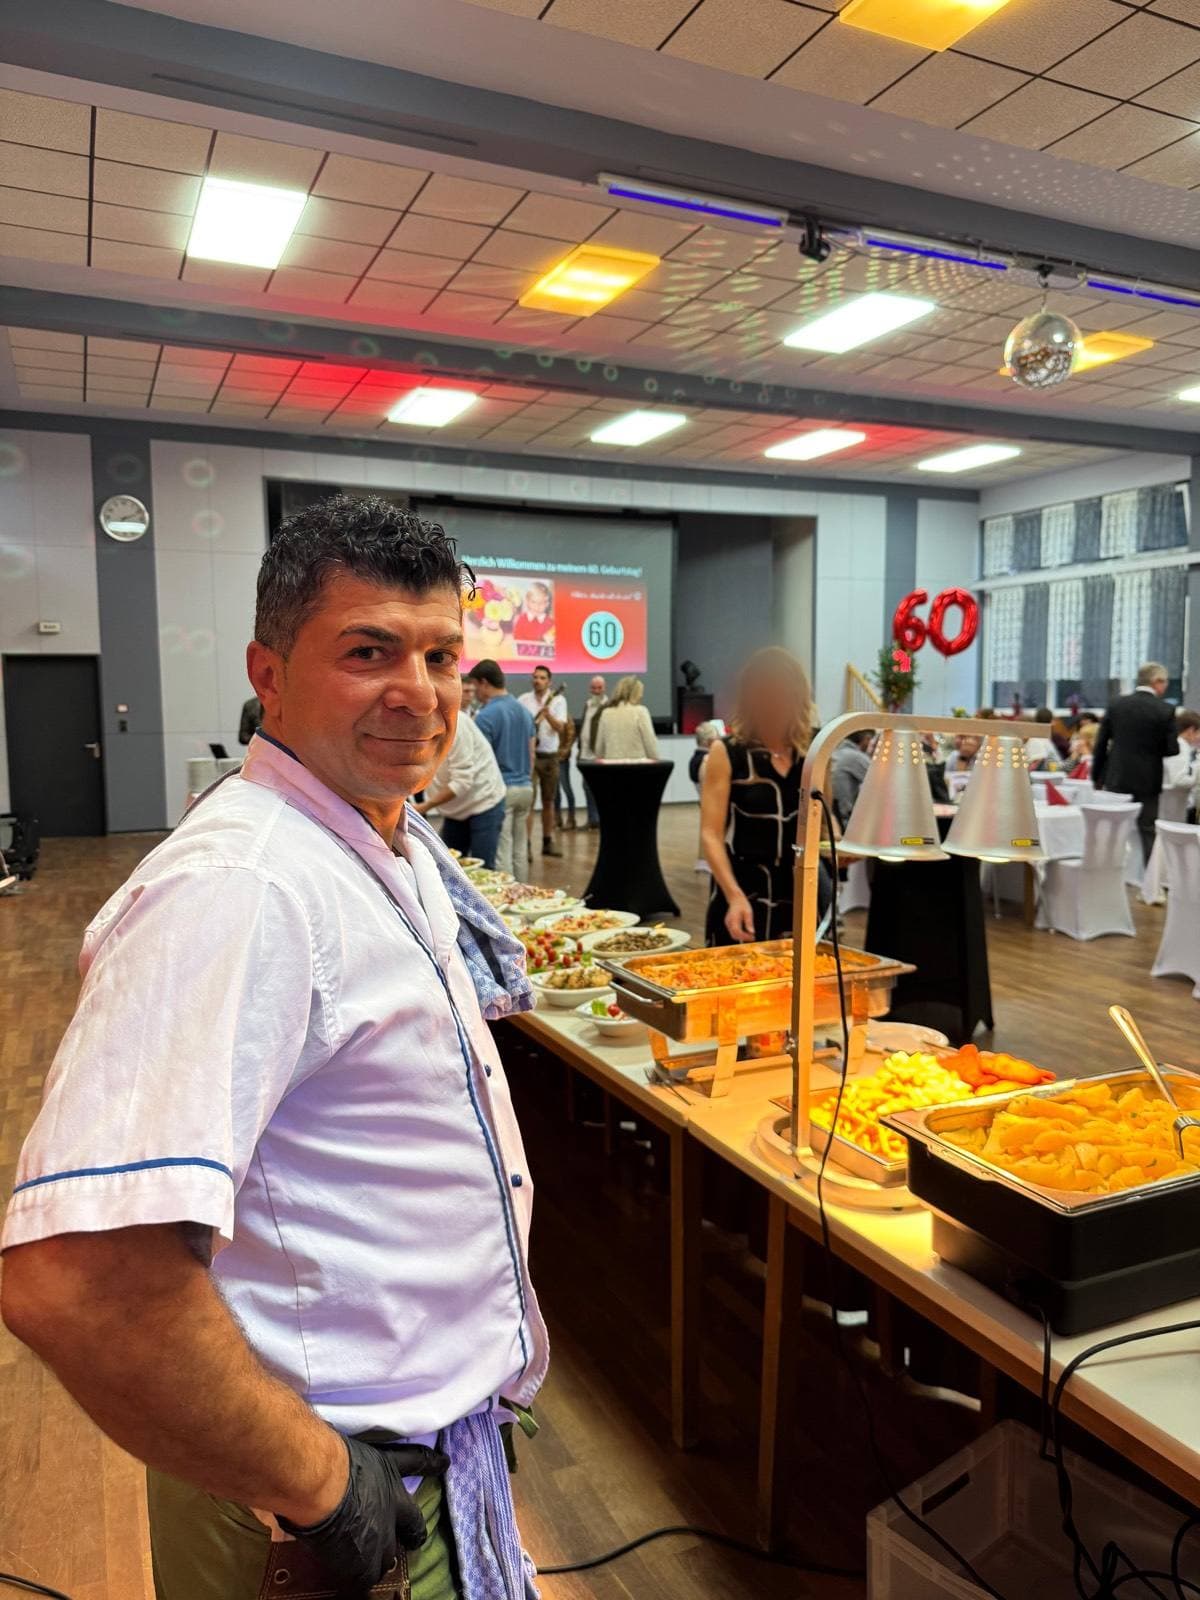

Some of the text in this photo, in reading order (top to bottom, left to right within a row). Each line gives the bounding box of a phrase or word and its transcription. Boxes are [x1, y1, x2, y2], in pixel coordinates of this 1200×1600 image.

[496, 557, 546, 571] Willkommen
[547, 562, 556, 572] zu
[588, 620, 617, 648] 60
[893, 587, 978, 657] 60
